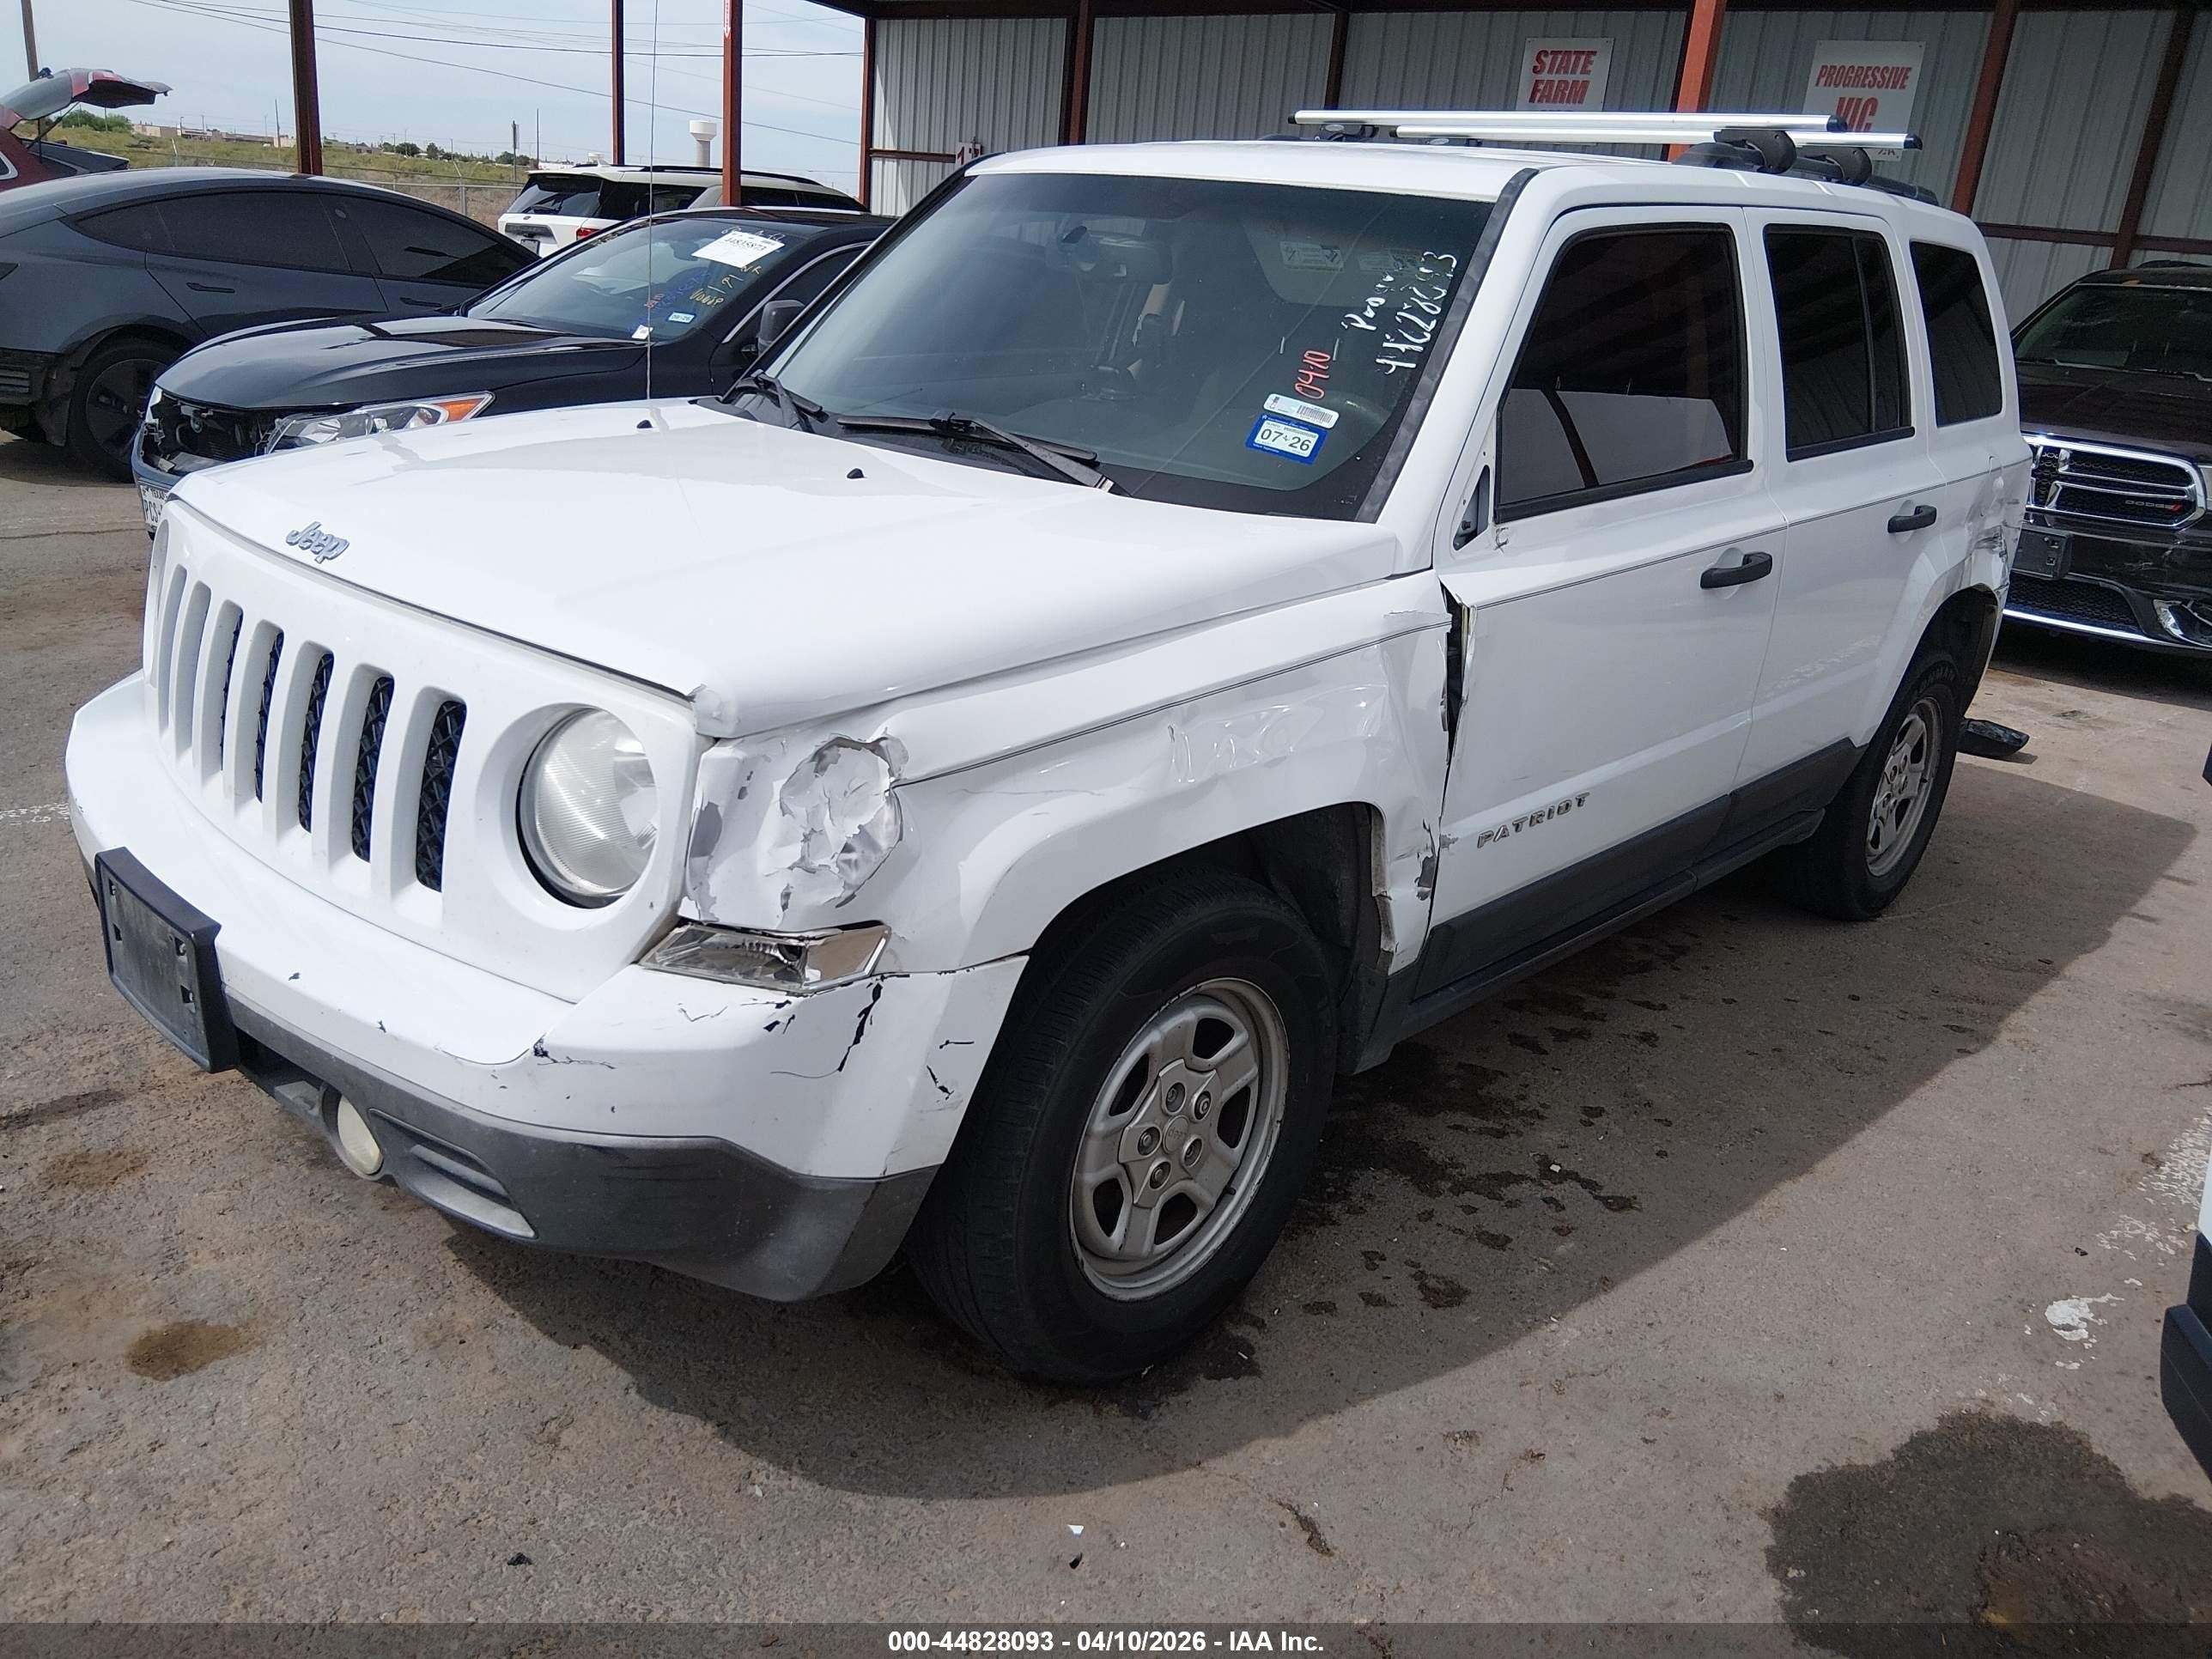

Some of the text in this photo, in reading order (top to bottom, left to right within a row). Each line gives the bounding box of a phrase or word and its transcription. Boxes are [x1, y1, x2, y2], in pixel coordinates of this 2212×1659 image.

[1532, 50, 1597, 76] STATE
[1814, 64, 1912, 90] PROGRESSIVE
[1528, 79, 1590, 104] FARM
[1835, 96, 1879, 132] VIC
[1288, 436, 1312, 452] 26
[2124, 500, 2172, 510] DODGE
[286, 520, 350, 565] Jeep
[1477, 792, 1590, 848] PATRIOT
